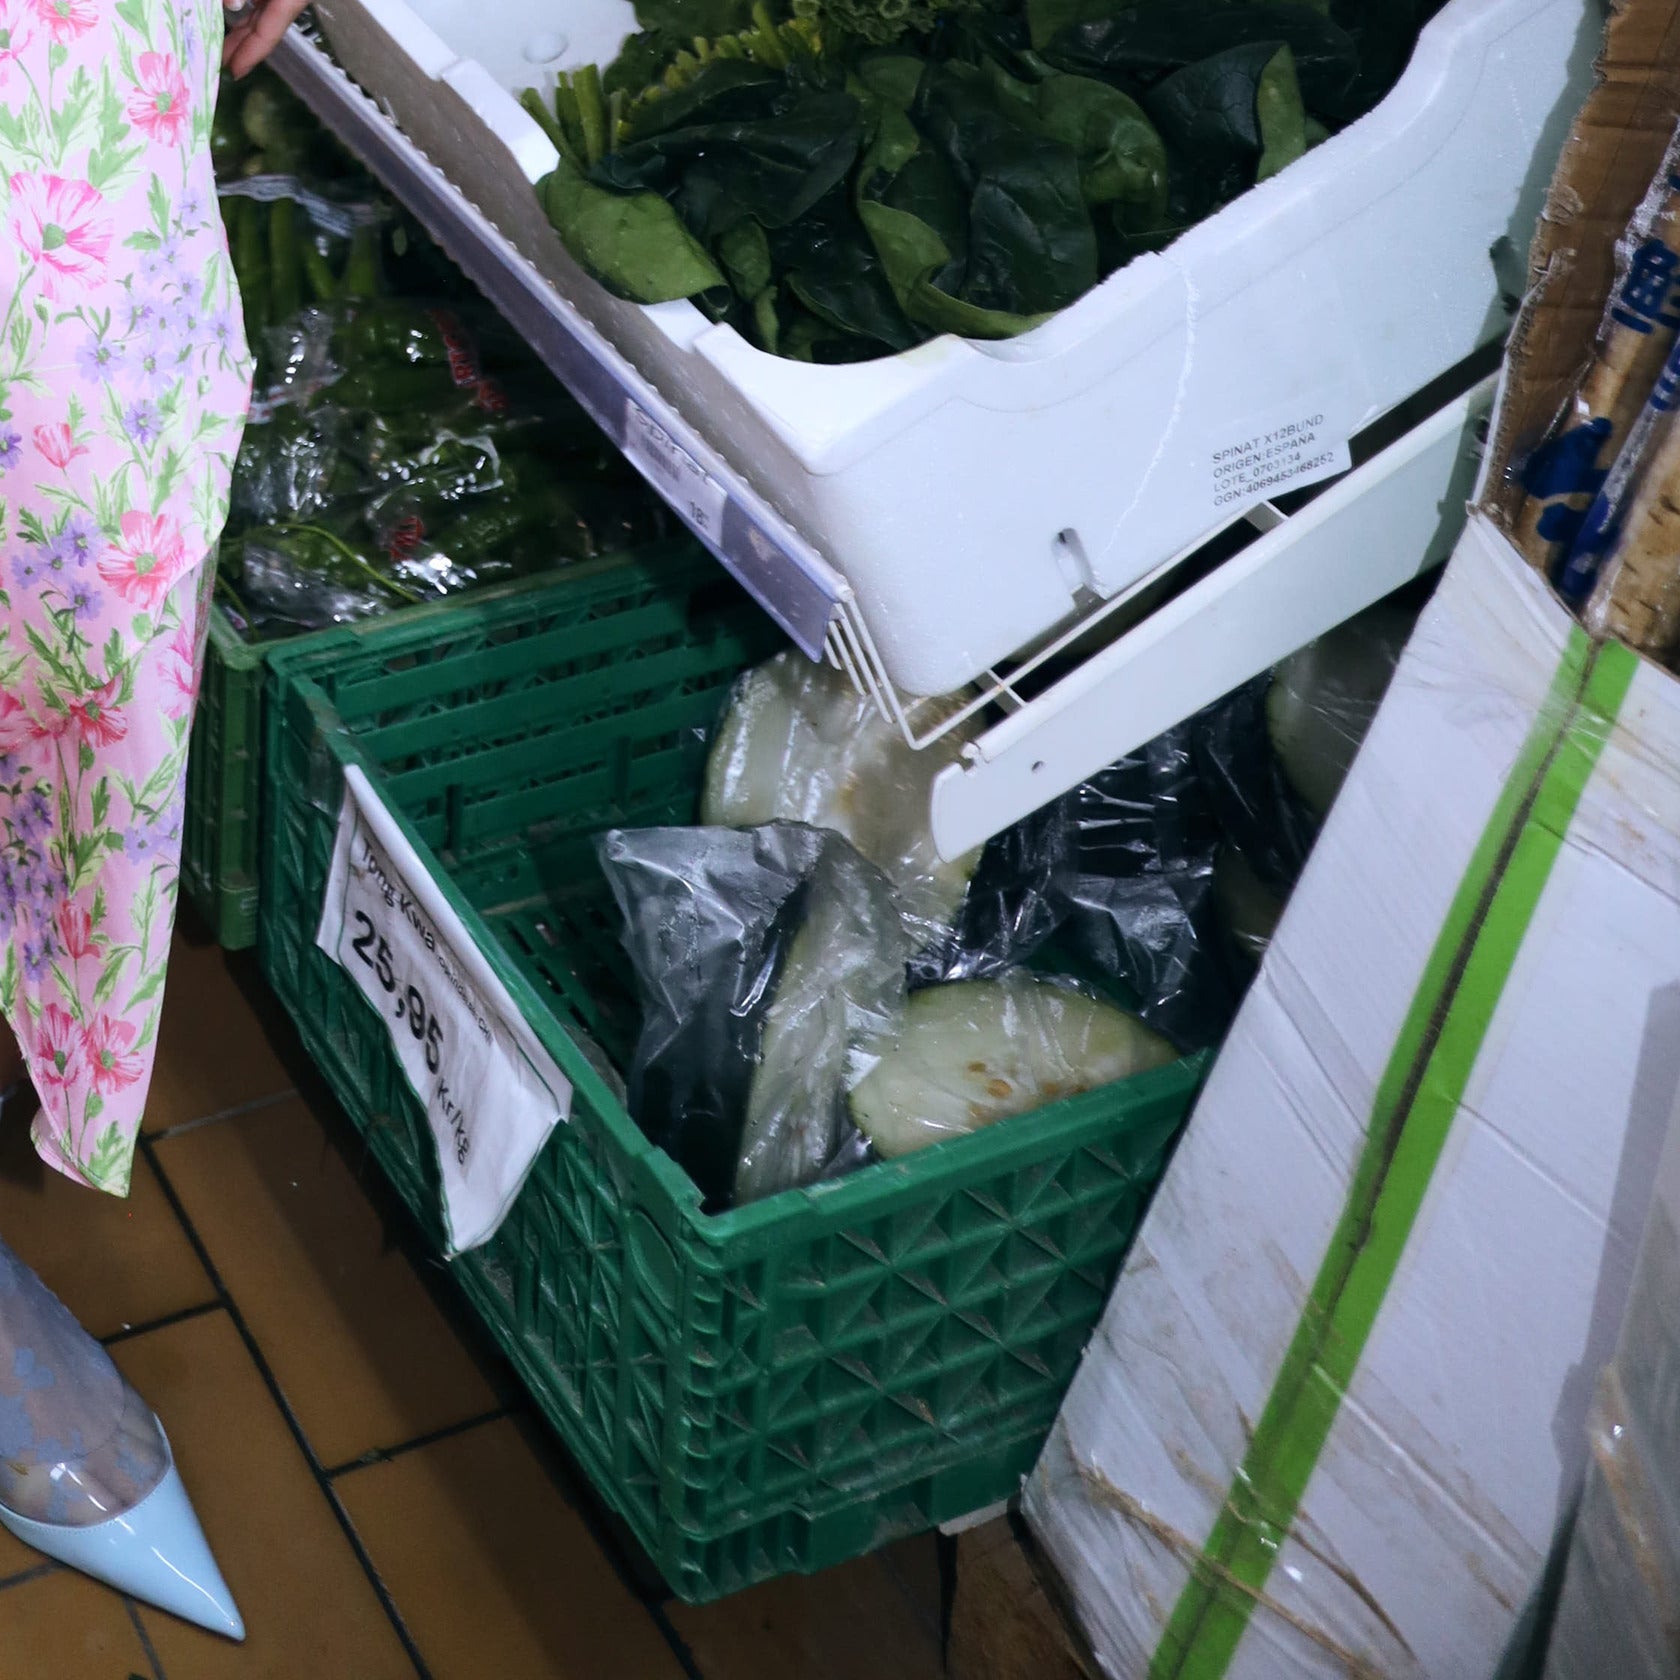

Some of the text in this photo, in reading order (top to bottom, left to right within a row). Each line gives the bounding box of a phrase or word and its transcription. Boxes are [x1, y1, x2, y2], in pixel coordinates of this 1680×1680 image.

[1213, 438, 1260, 464] SPINAT
[362, 839, 396, 907] Tong
[398, 893, 437, 954] Kwa
[352, 910, 444, 1075] 25,95
